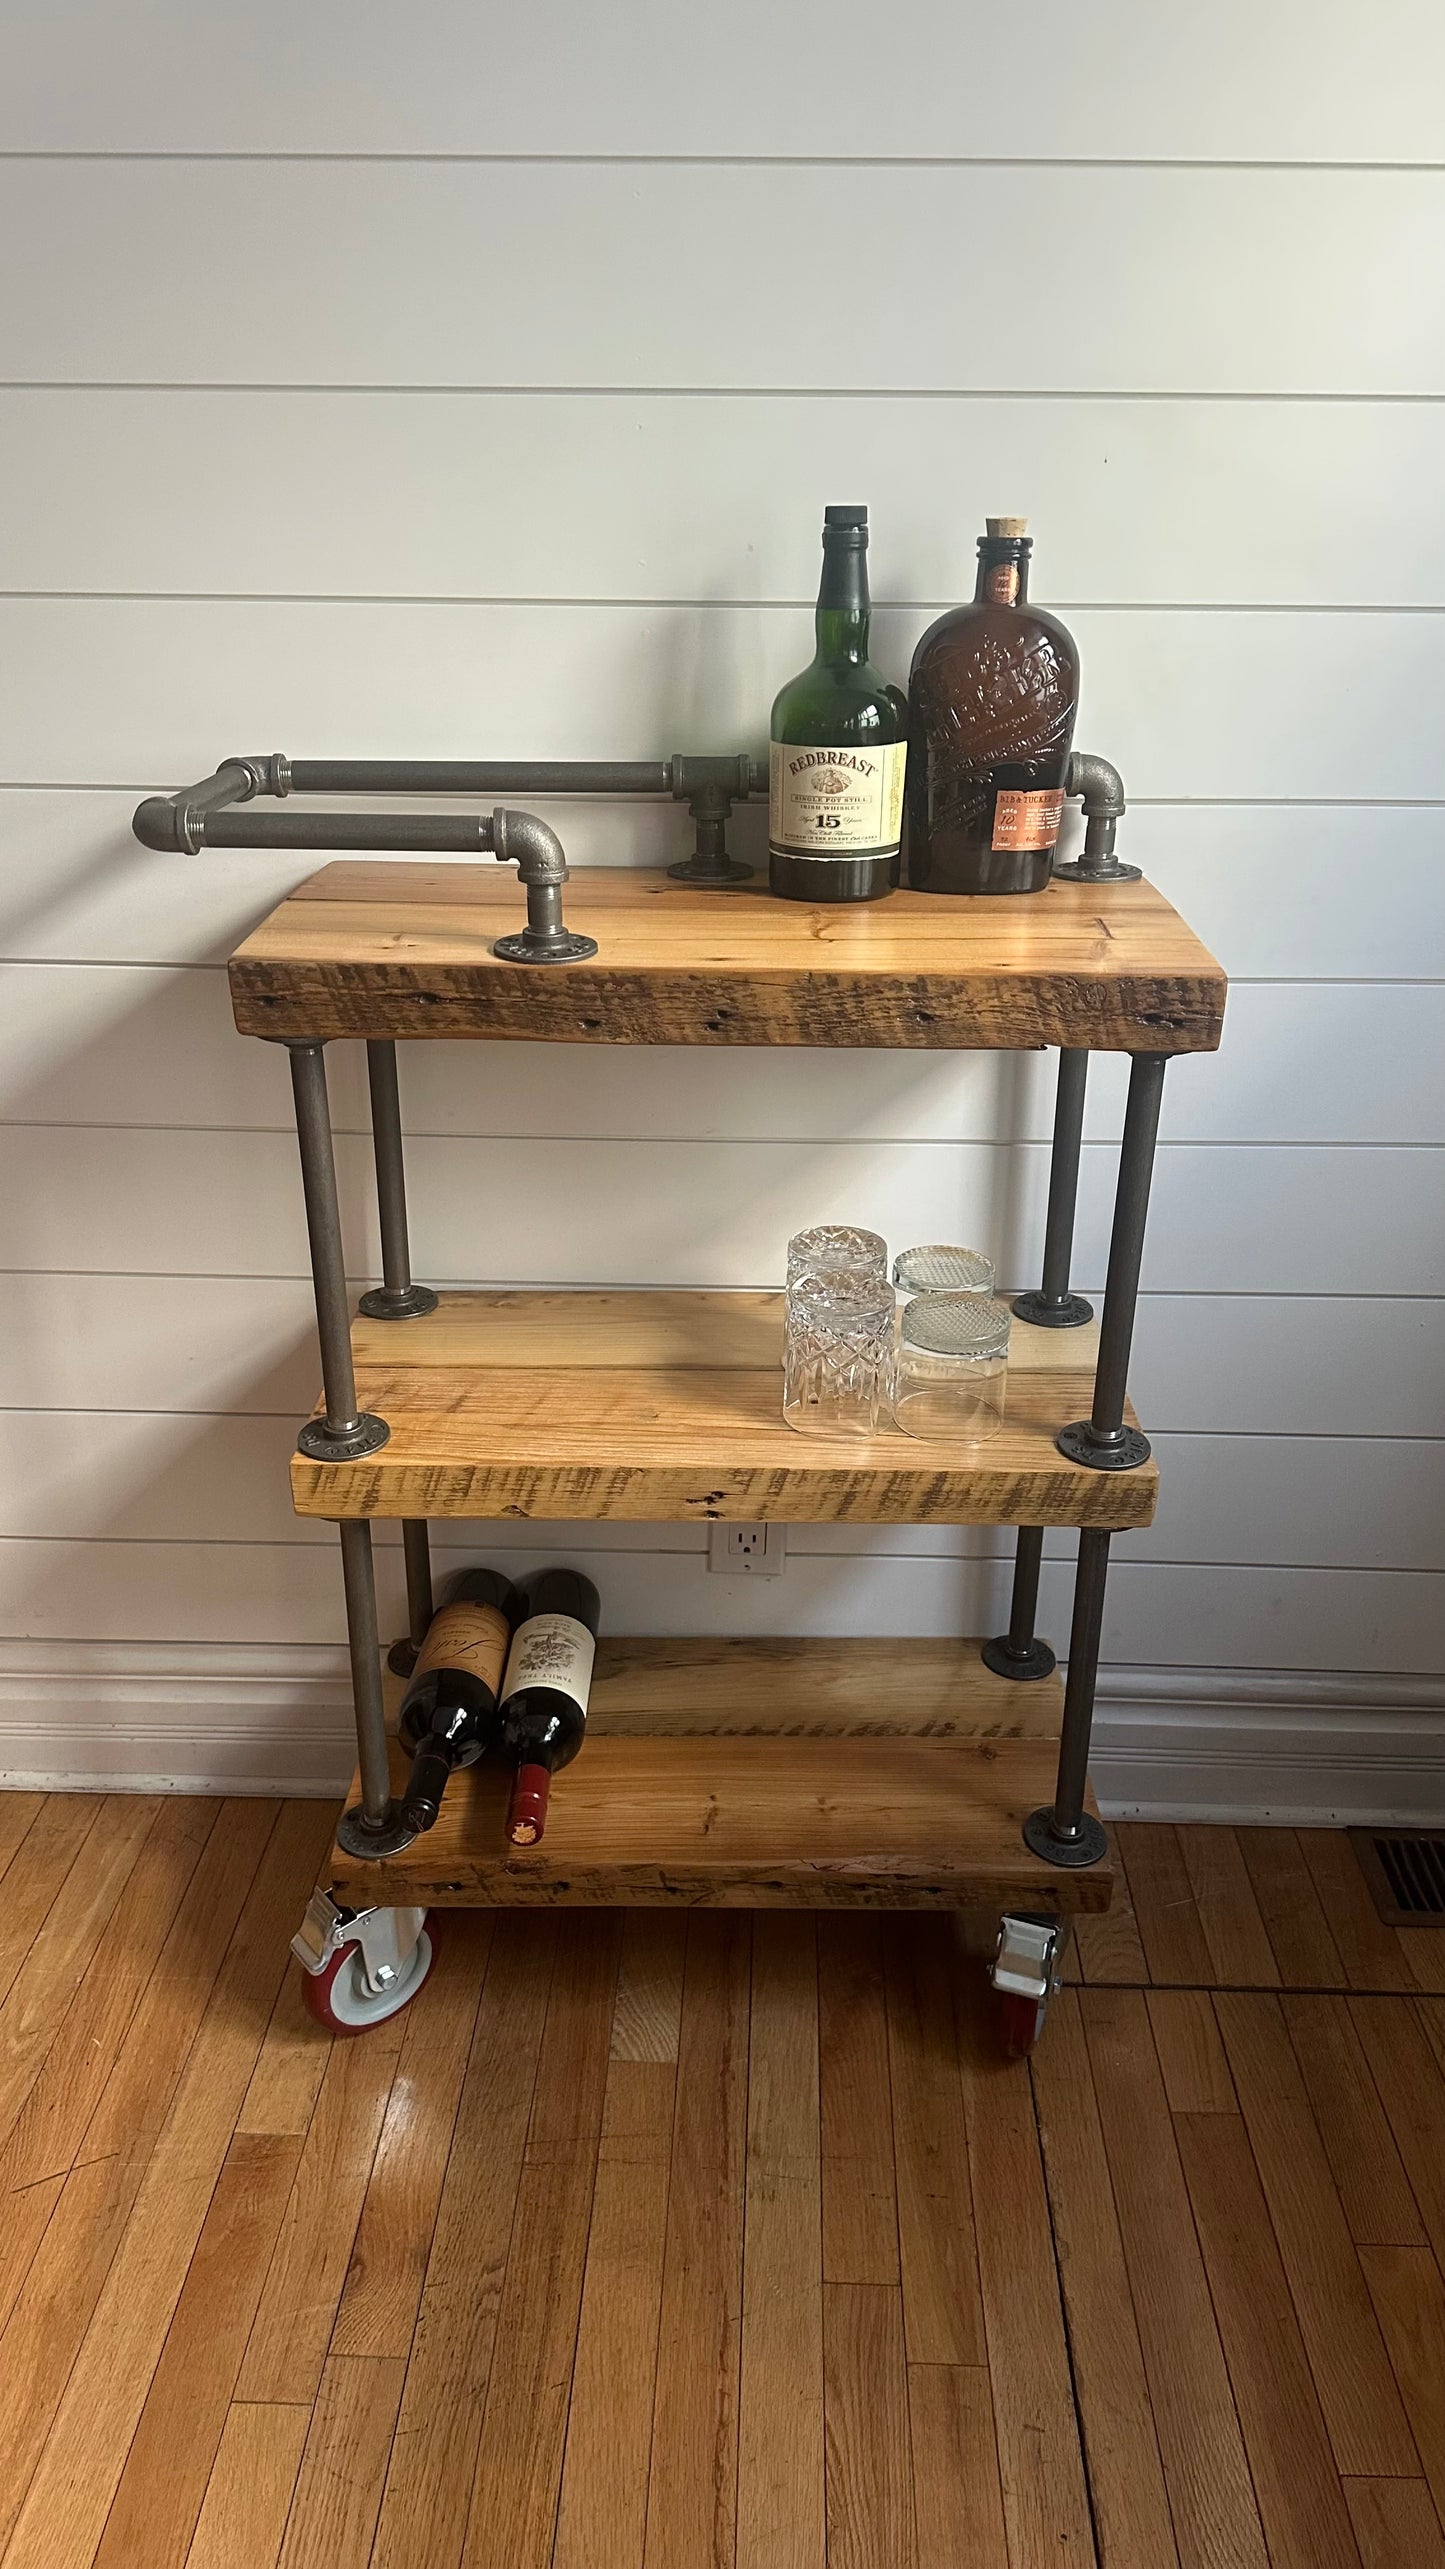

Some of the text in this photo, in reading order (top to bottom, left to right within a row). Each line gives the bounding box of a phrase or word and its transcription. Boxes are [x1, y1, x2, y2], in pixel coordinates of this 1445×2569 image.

[788, 751, 876, 777] REDBREAST
[1000, 795, 1015, 803] BIB
[1023, 795, 1052, 803] TUCKER
[815, 814, 842, 829] 15
[1001, 815, 1015, 825] 10
